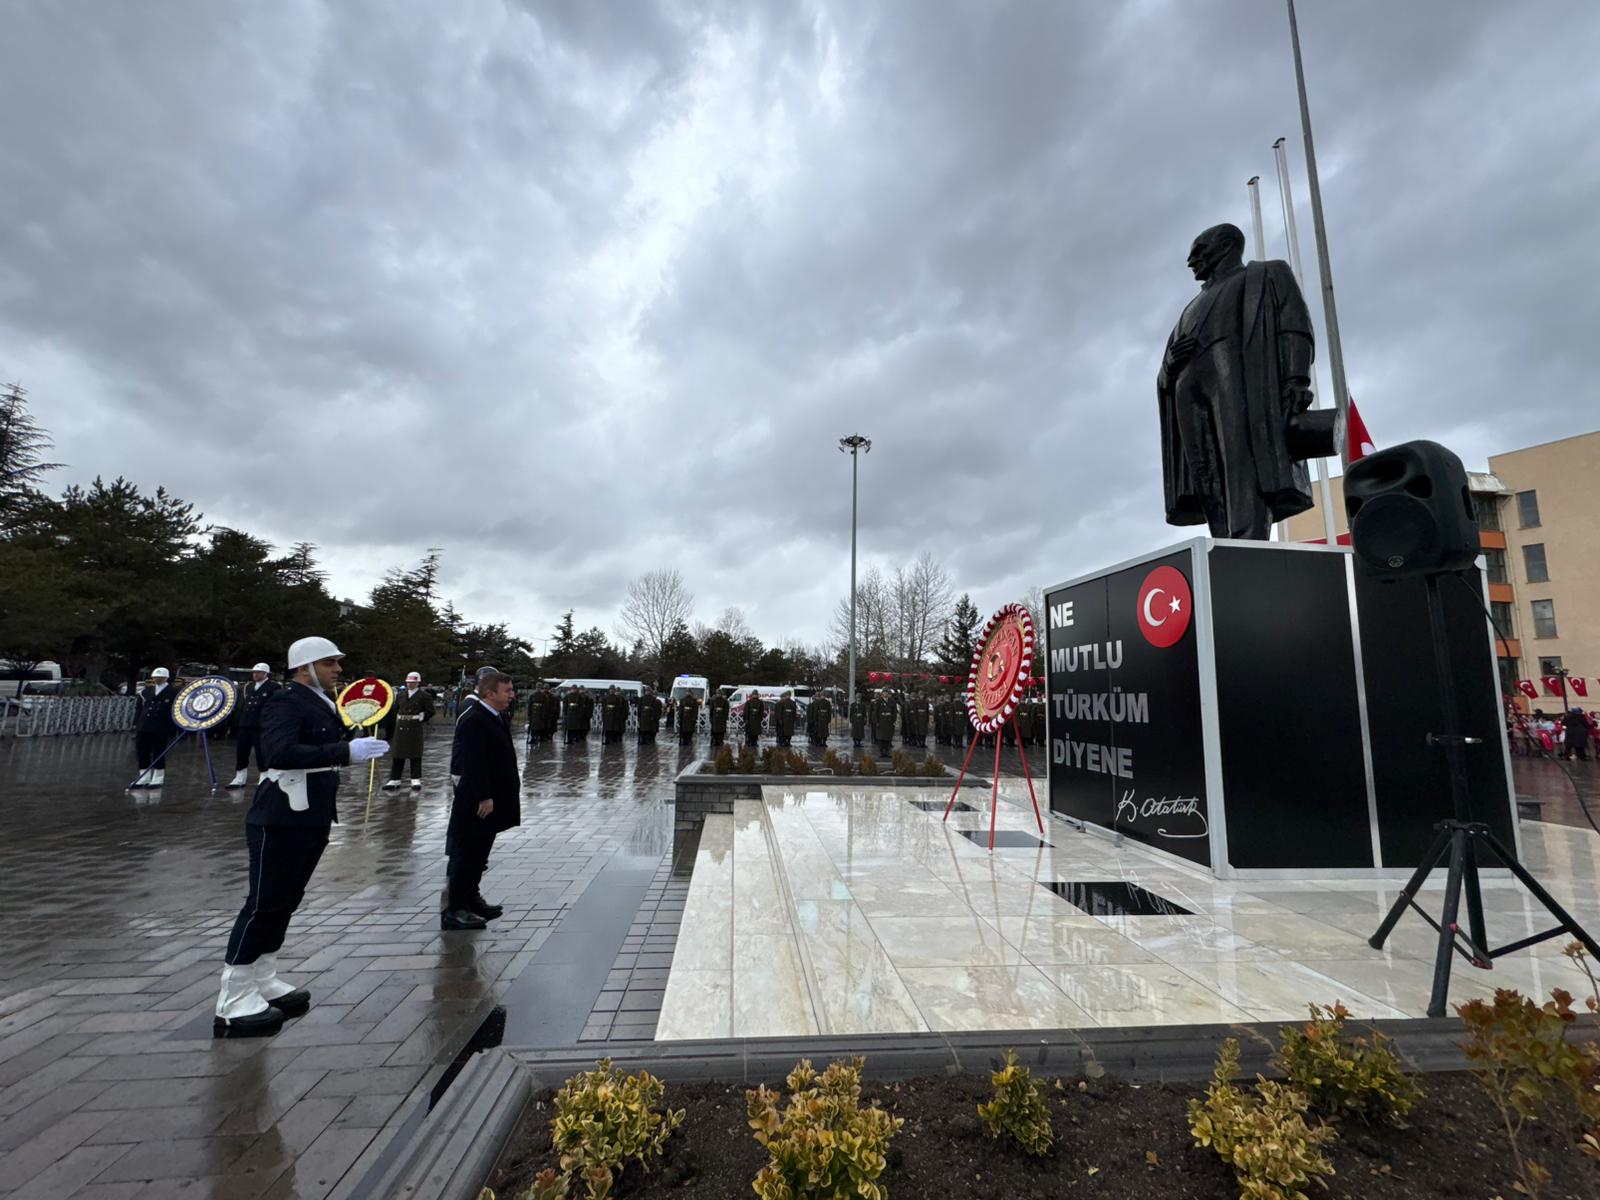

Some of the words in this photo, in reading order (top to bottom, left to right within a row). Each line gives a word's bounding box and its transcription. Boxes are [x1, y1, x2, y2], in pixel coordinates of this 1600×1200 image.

[1050, 601, 1074, 629] NE
[1051, 640, 1123, 673] MUTLU
[1052, 686, 1149, 723] TÜRKÜM
[1053, 732, 1134, 779] DİYENE
